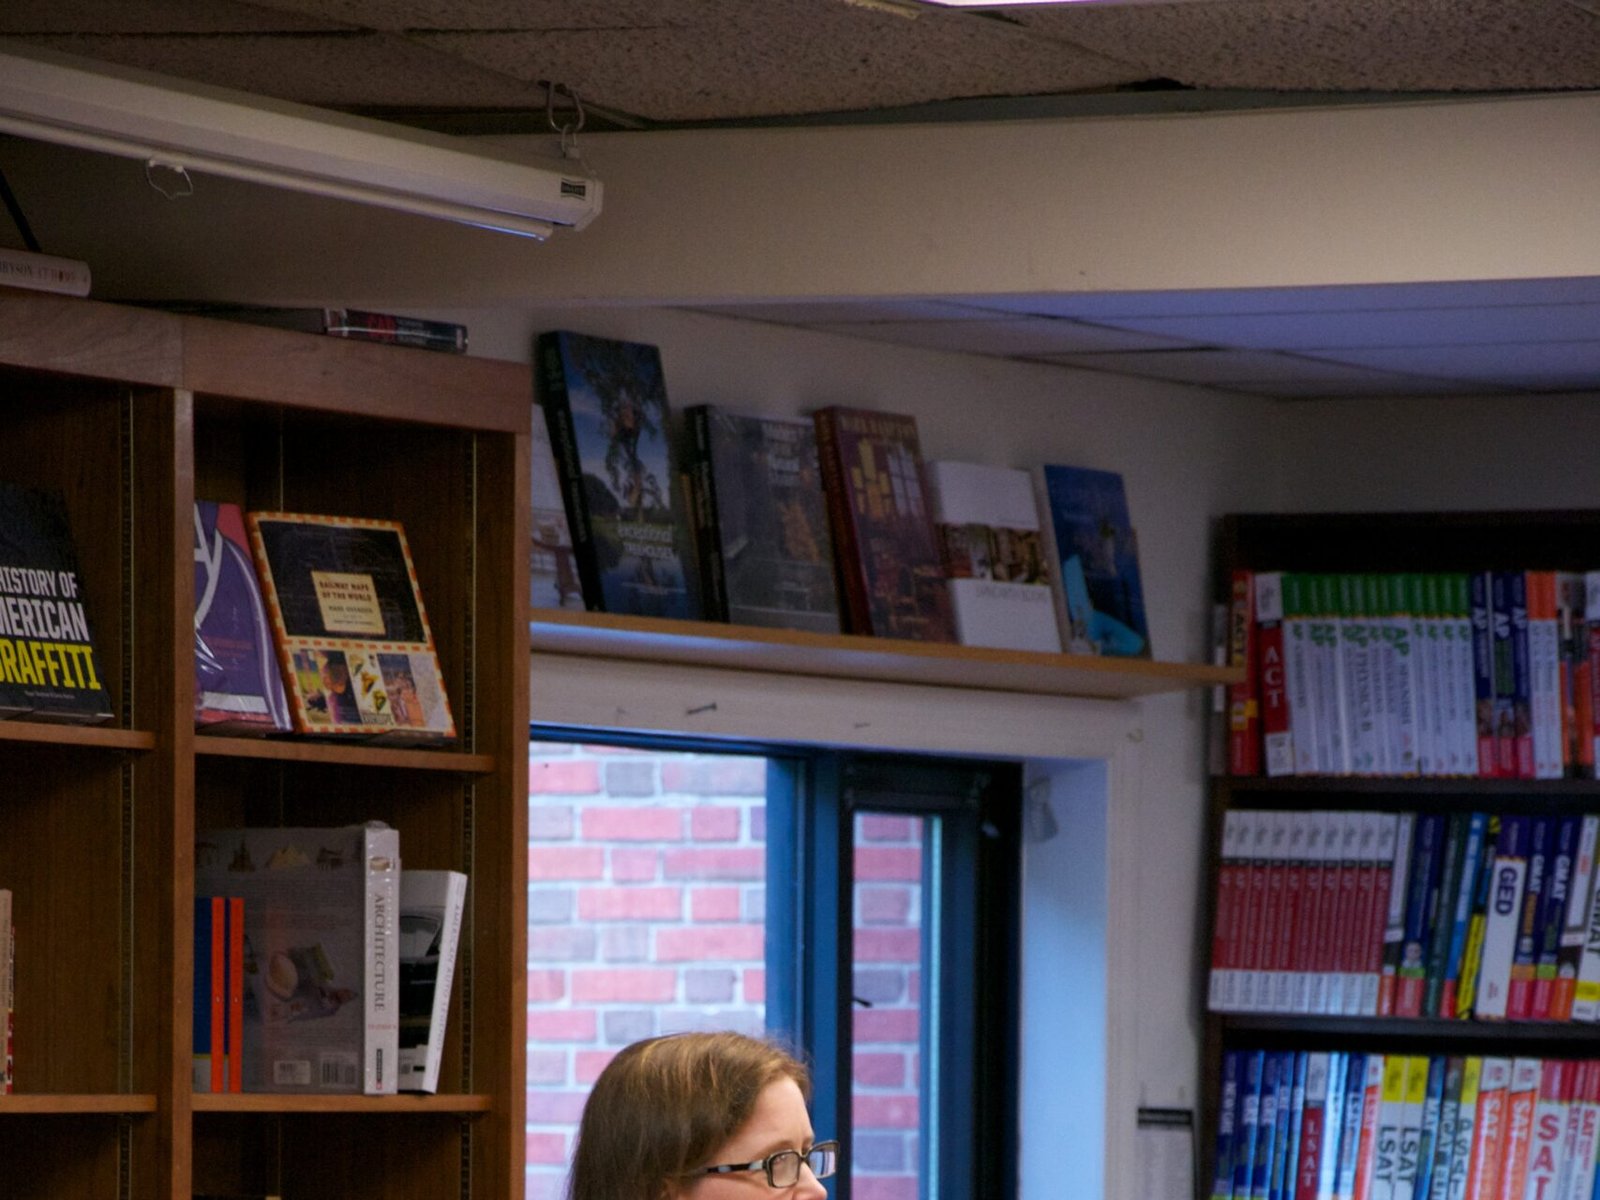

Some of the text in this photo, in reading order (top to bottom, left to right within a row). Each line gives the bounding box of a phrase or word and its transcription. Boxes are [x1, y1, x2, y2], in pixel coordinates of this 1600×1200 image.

[58, 571, 78, 599] OF
[0, 596, 90, 642] MERICAN
[0, 638, 102, 690] RAFFITI
[1495, 867, 1518, 916] GED
[1551, 854, 1571, 901] GMAT
[373, 893, 386, 1013] ARCHITECTURE
[1482, 1098, 1501, 1139] SAT
[1512, 1100, 1531, 1140] SAT
[1376, 1126, 1397, 1185] LSAT
[1398, 1126, 1420, 1185] LSAT
